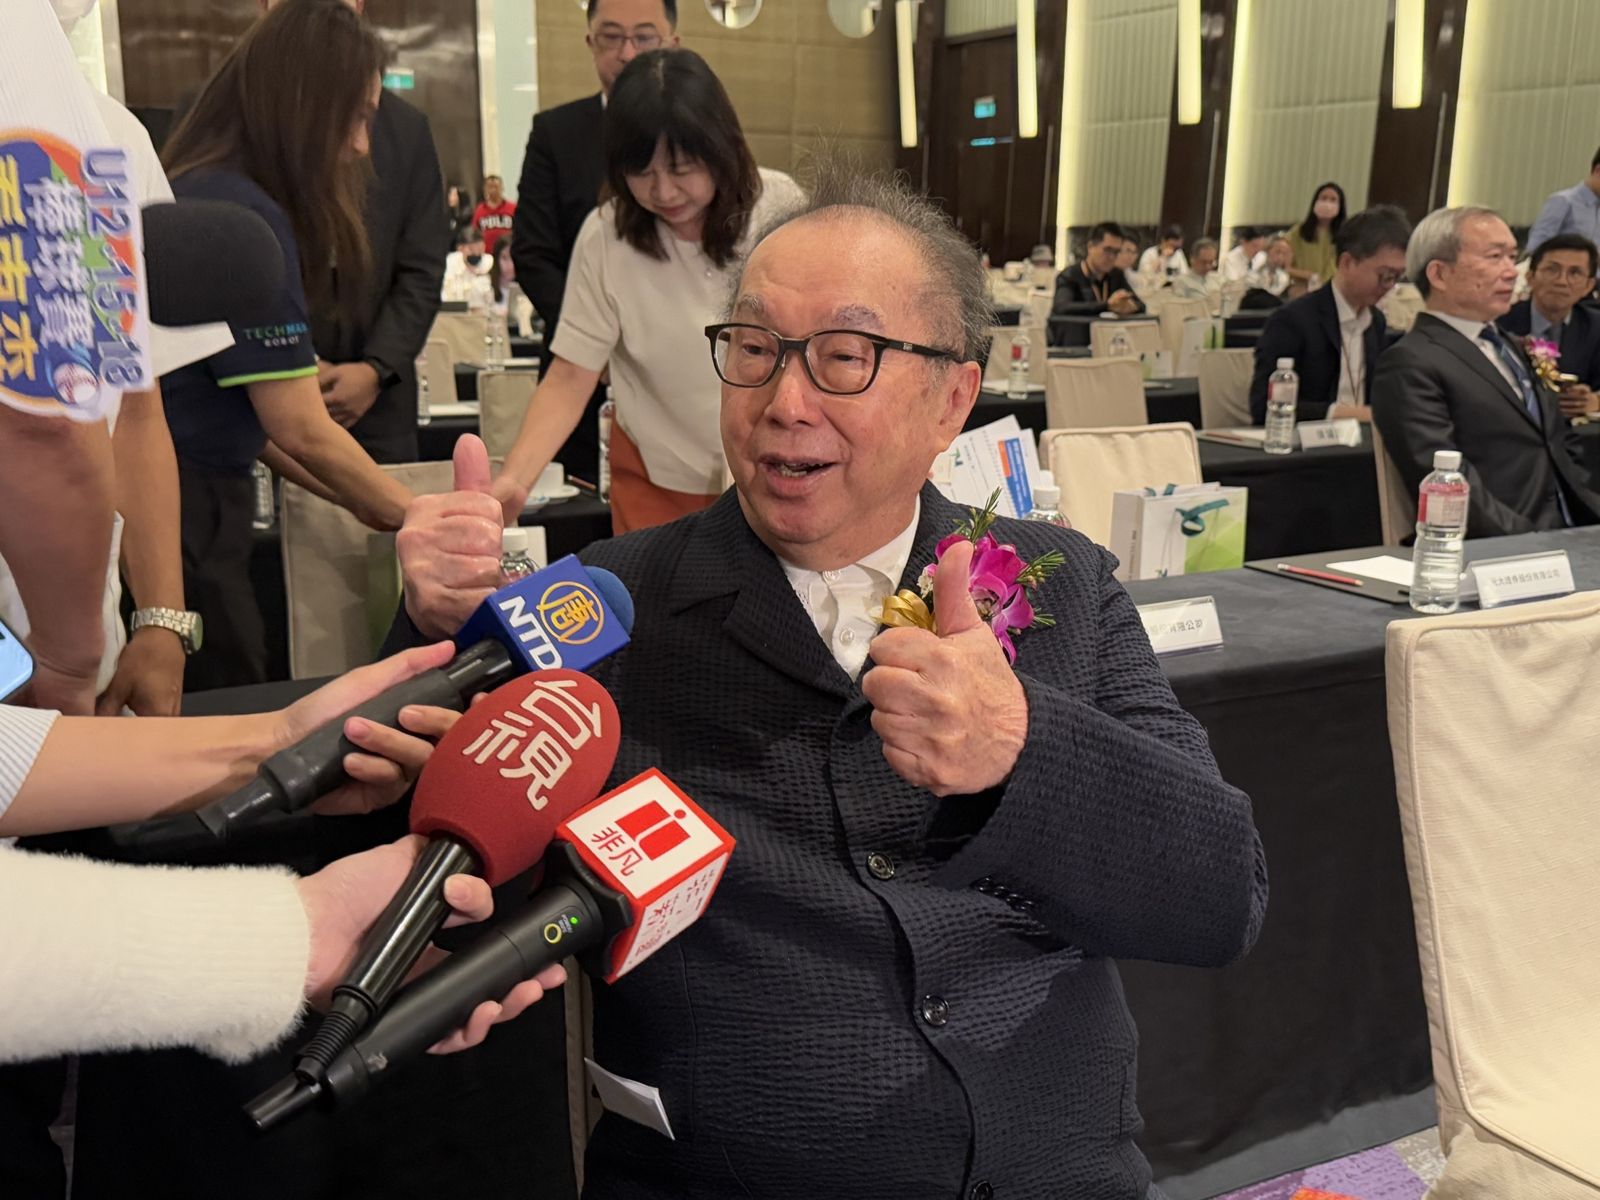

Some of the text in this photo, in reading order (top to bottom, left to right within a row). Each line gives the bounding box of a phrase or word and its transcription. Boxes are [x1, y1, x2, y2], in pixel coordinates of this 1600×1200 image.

[24, 178, 96, 349] 棒球賽
[499, 596, 564, 670] NTD
[462, 679, 602, 811] 台視
[590, 825, 647, 876] 非凡
